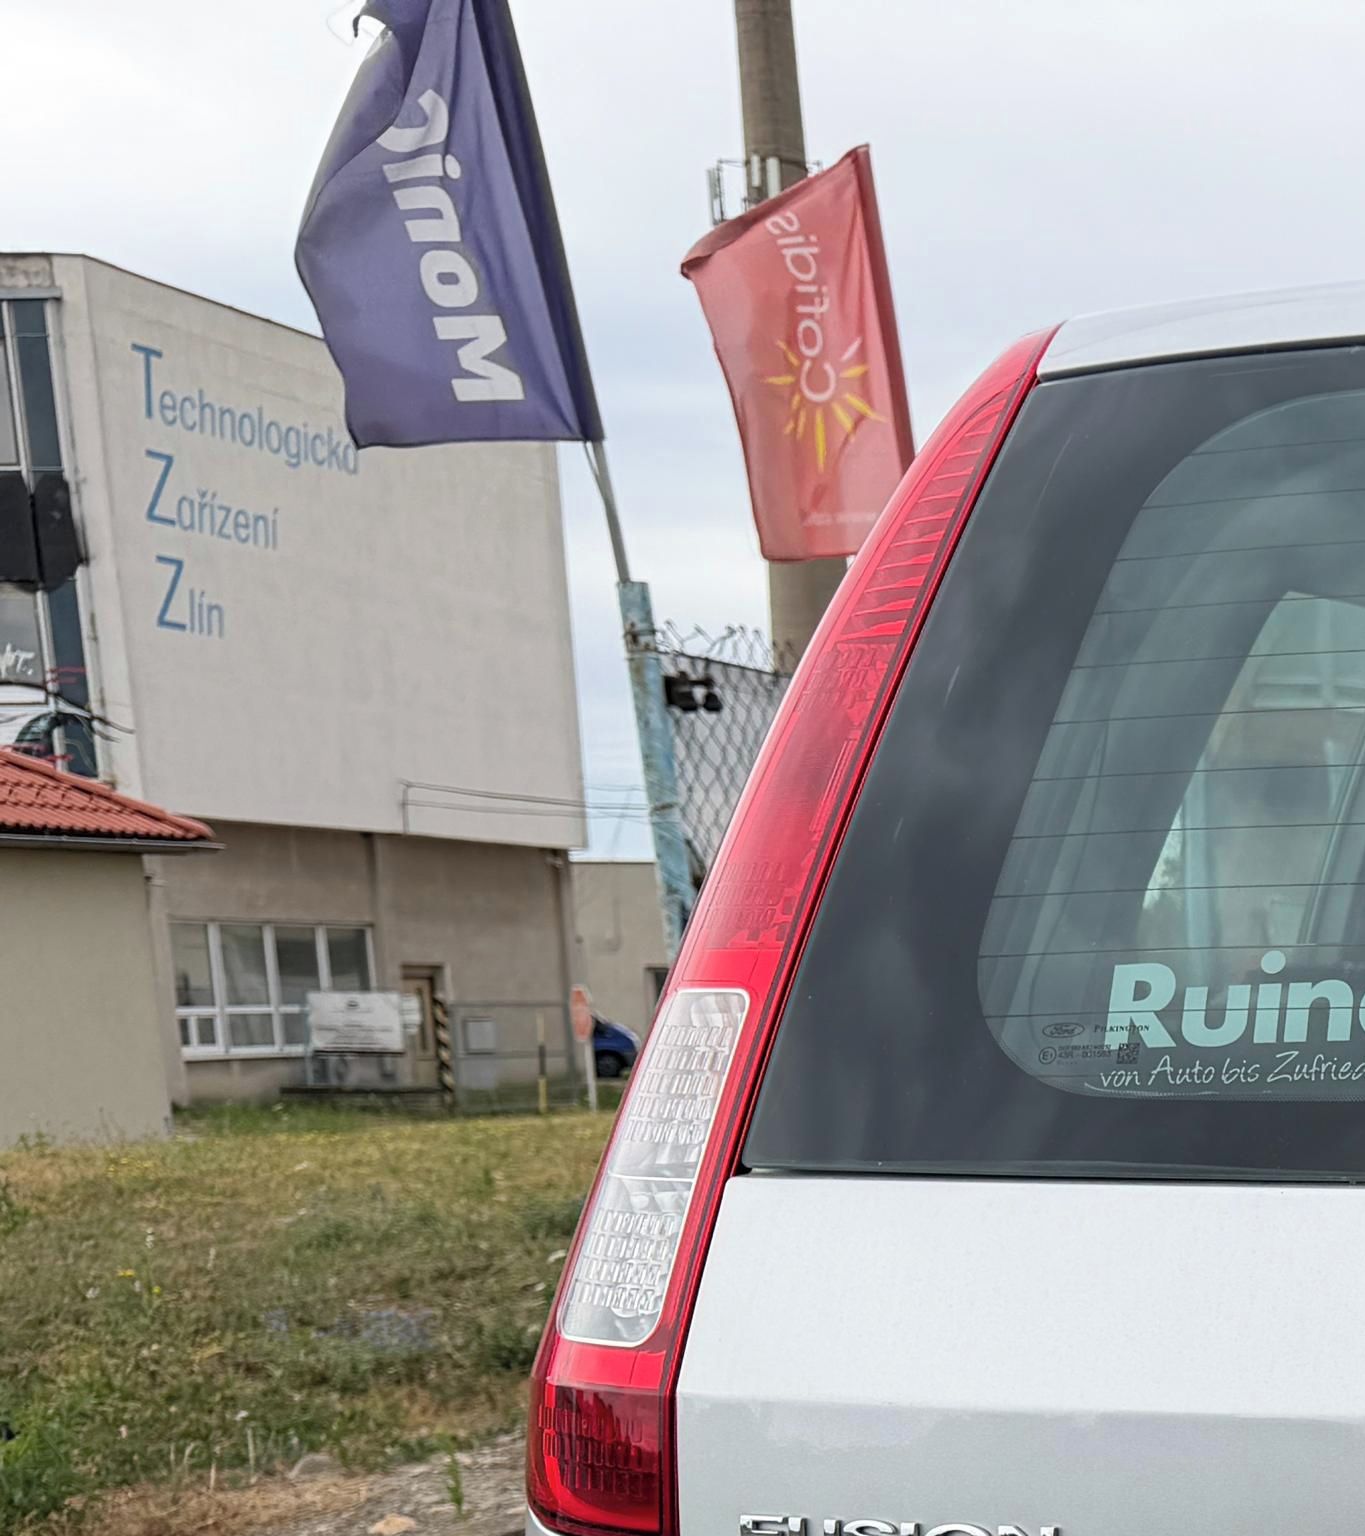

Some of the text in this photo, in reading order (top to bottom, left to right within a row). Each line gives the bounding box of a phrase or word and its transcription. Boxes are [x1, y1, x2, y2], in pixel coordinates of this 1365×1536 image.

[145, 448, 280, 550] Zařízení
[155, 554, 225, 639] Zlín
[1100, 1070, 1142, 1088] von
[1148, 1055, 1216, 1086] Auto
[1222, 1058, 1260, 1083] bis
